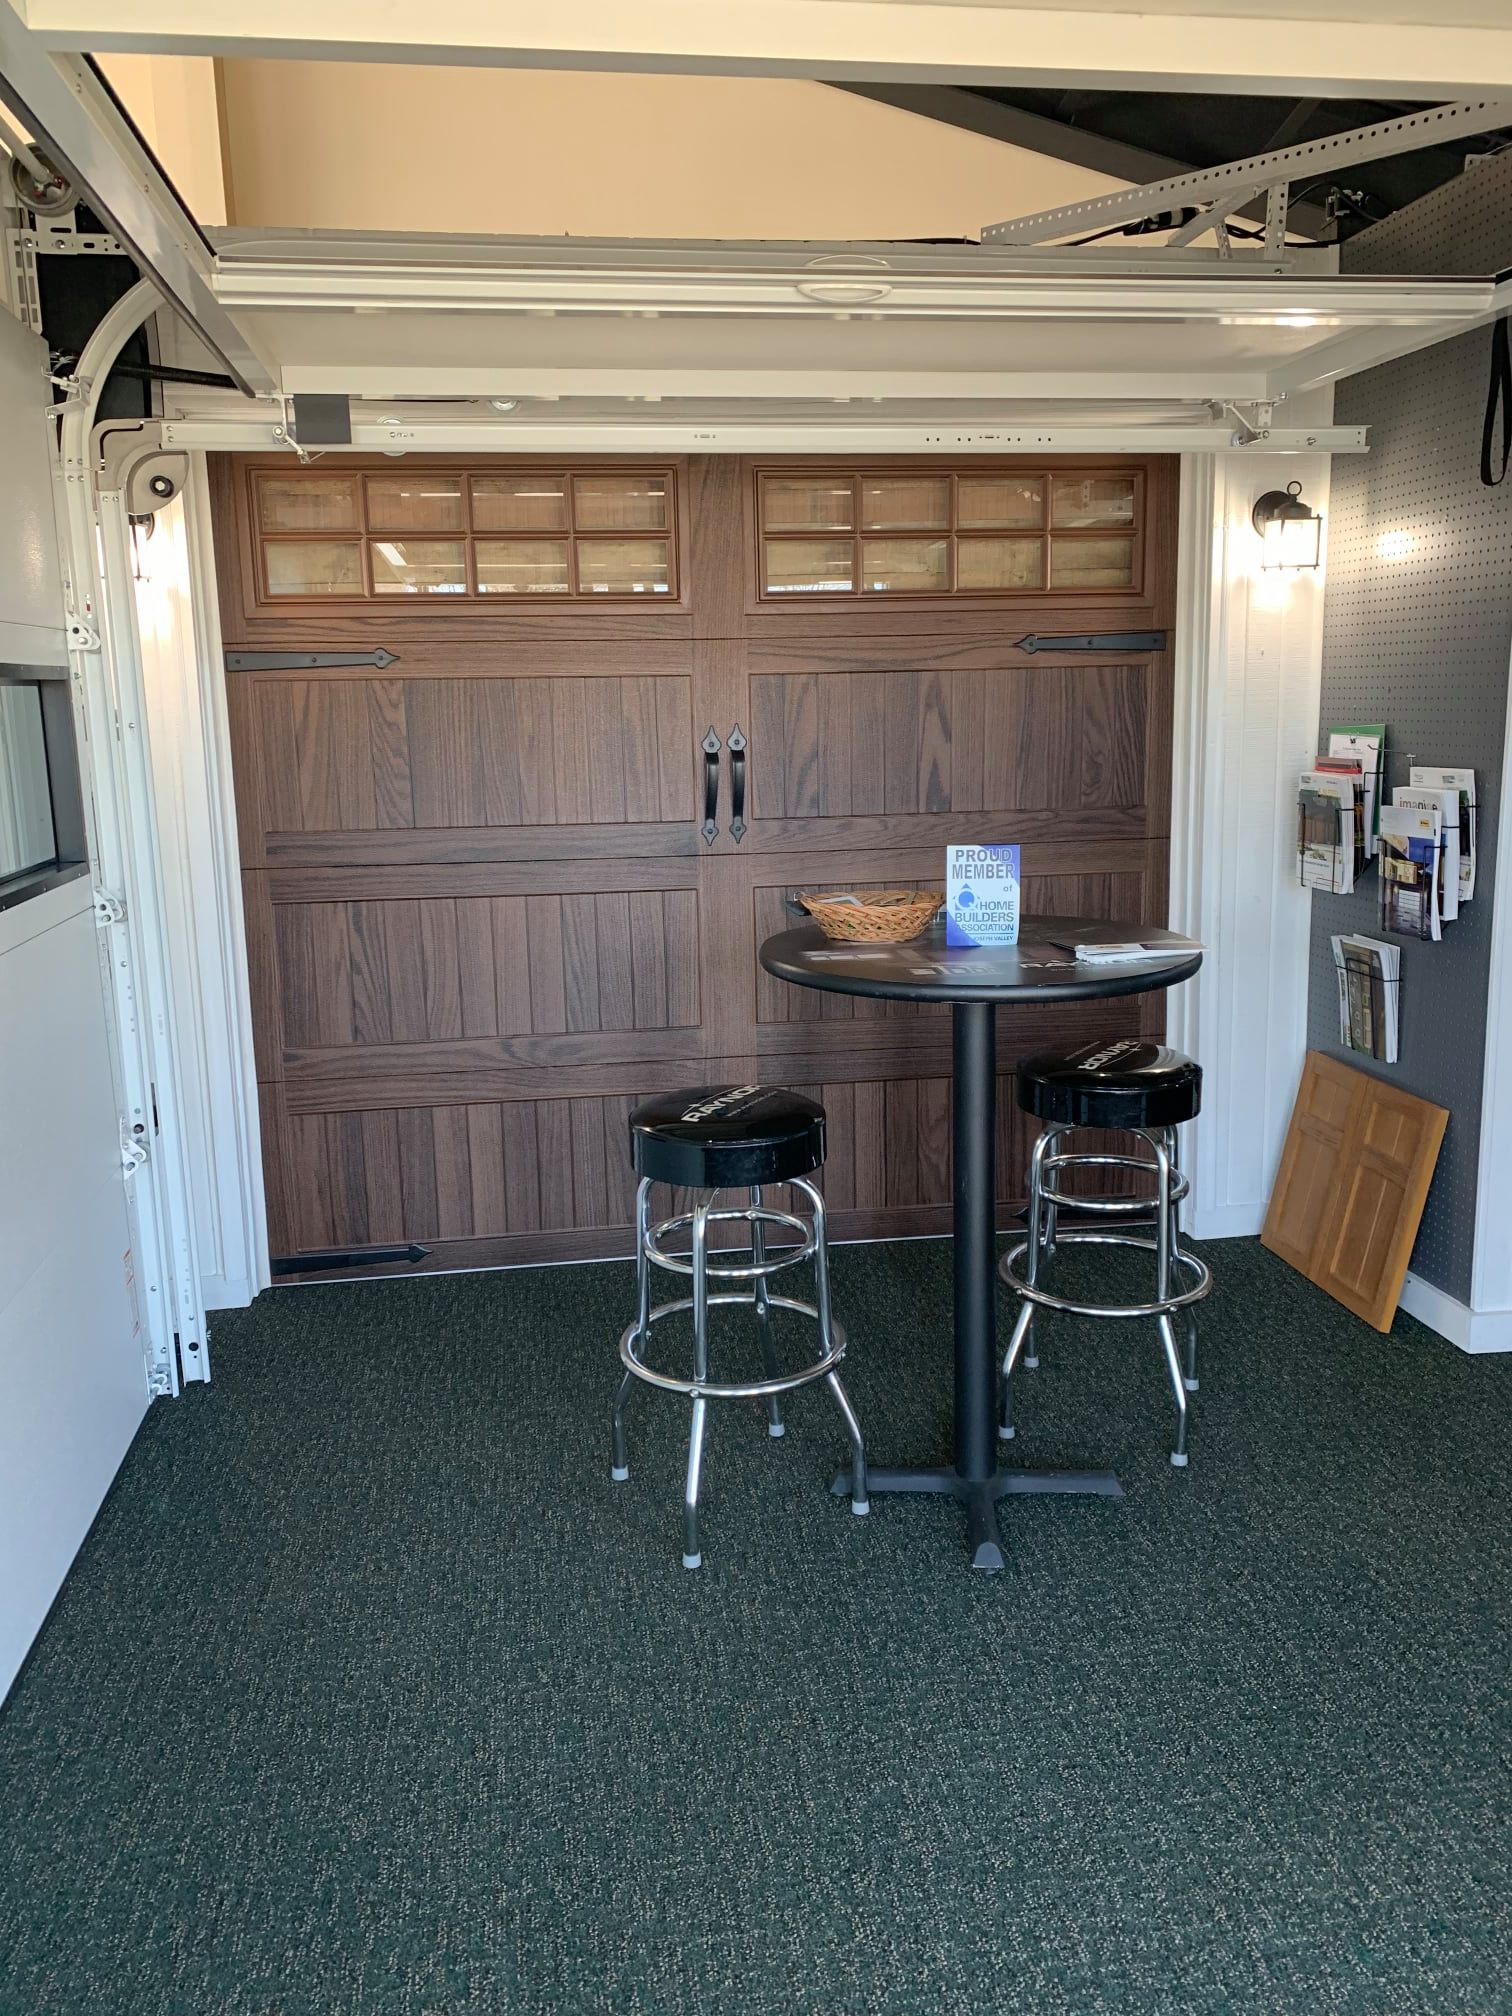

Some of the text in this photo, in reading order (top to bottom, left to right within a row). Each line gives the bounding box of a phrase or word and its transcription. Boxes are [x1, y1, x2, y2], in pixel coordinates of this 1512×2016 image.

[955, 848, 1013, 863] PROUD
[952, 863, 1014, 879] MEMBER
[1003, 884, 1013, 892] of
[980, 900, 1015, 911] HOME
[955, 912, 1014, 923] BUILDERS
[957, 923, 1014, 932] ASSOCIATION
[1077, 1040, 1139, 1070] RAYNOR
